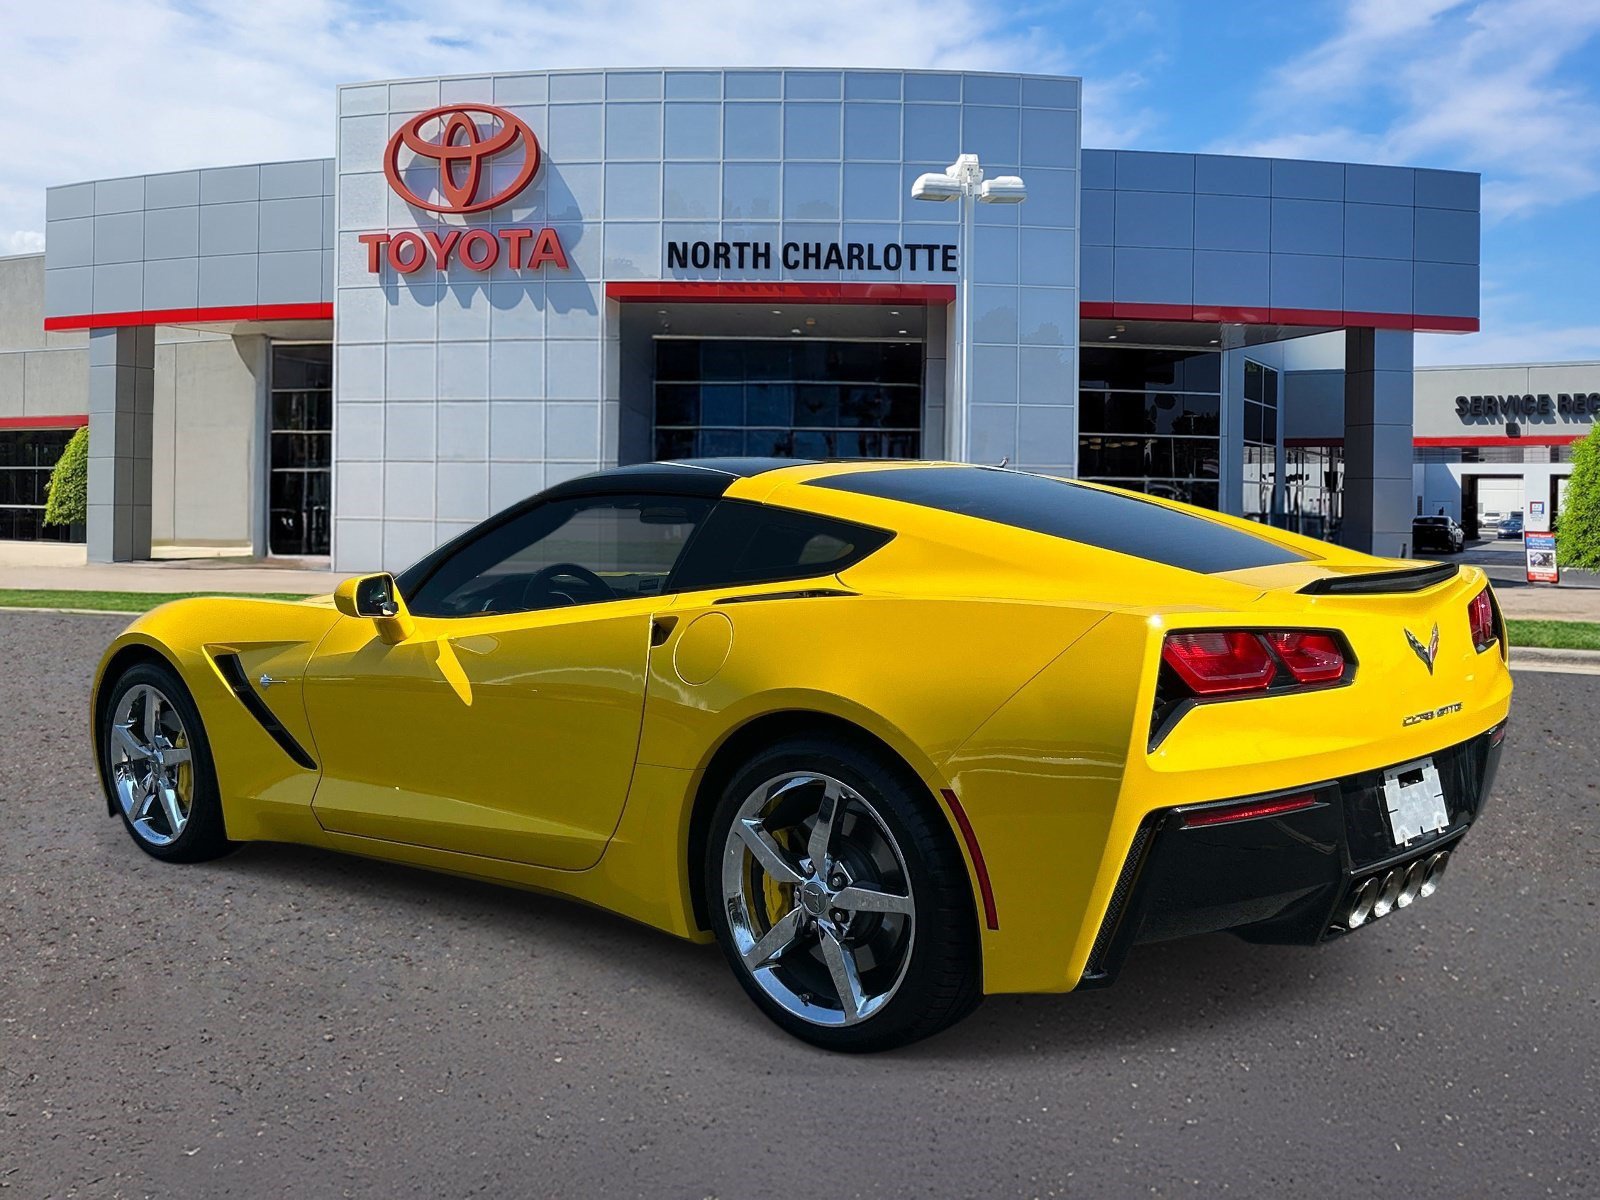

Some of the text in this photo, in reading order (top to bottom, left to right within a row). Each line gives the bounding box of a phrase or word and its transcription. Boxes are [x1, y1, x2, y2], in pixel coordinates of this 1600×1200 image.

[358, 227, 569, 274] TOYOTA
[667, 241, 958, 272] NORTH CHARLOTTE
[1455, 393, 1552, 416] SERVICE
